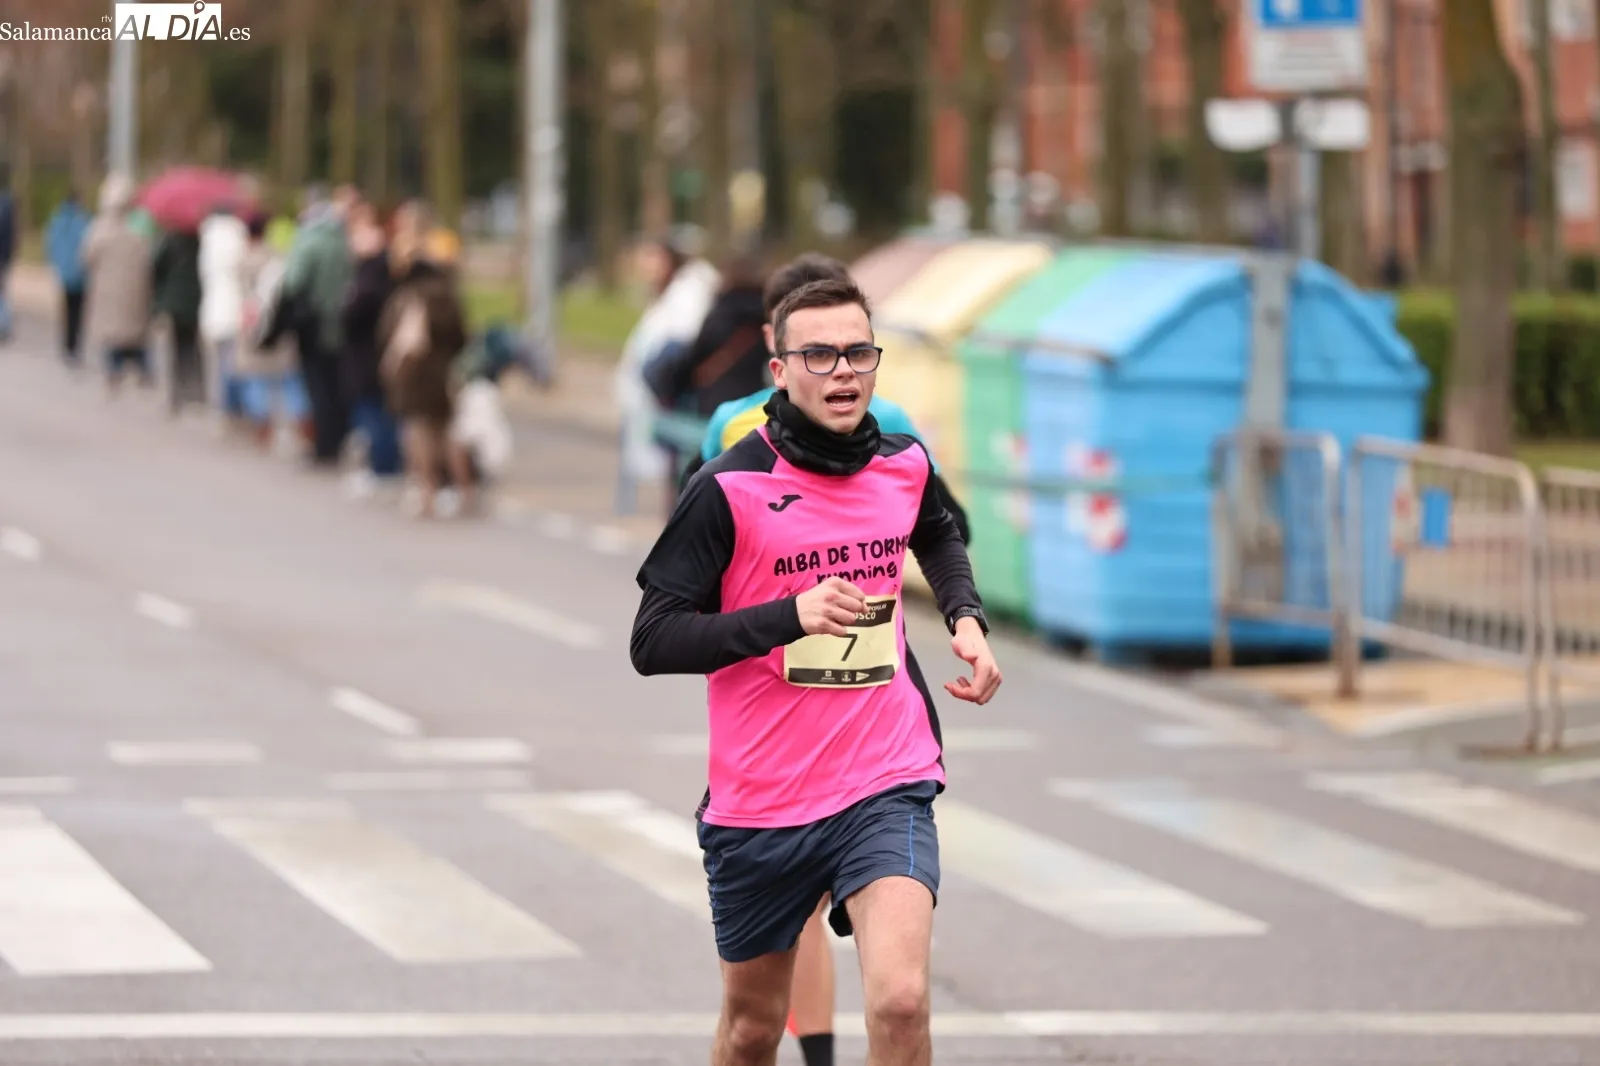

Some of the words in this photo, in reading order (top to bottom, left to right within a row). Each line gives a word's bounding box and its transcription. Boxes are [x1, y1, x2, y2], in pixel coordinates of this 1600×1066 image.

[773, 550, 821, 577] ALBA
[827, 545, 850, 566] DE
[840, 633, 858, 662] 7
